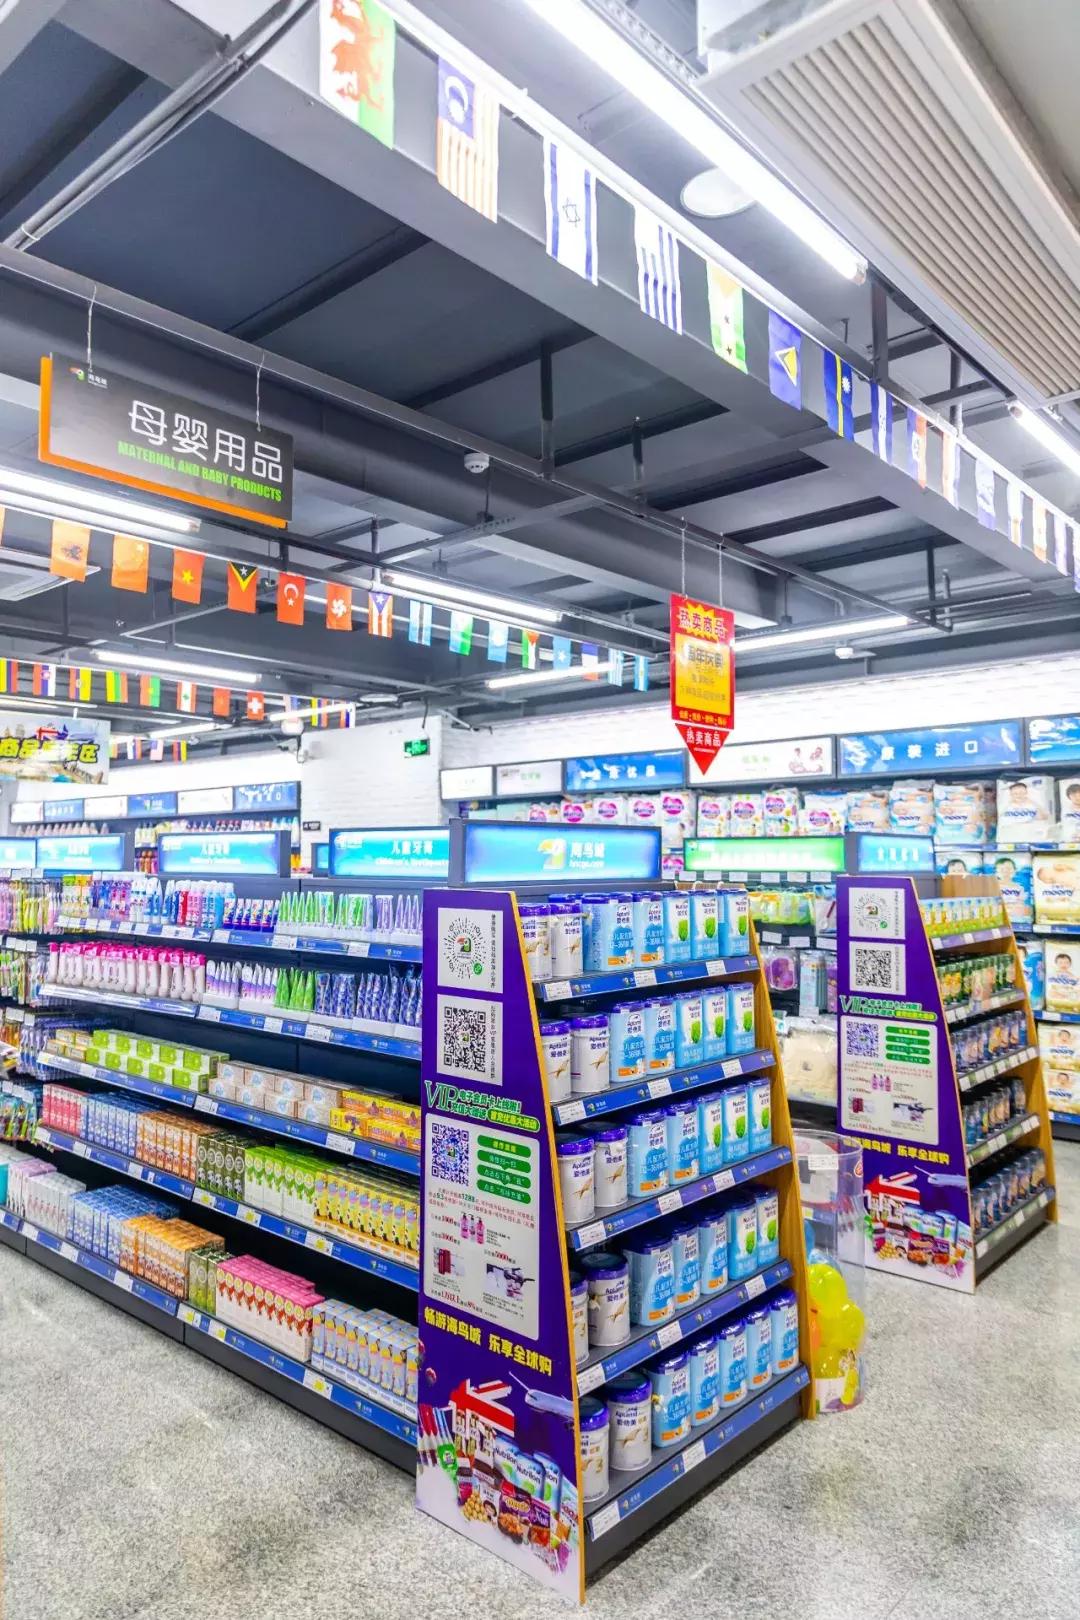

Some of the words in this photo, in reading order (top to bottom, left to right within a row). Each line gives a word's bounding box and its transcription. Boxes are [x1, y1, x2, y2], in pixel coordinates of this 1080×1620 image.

[128, 400, 283, 483] 母婴用品
[117, 441, 177, 471] MATERNAL
[178, 460, 200, 478] AND
[202, 466, 229, 486] BABY
[230, 475, 283, 502] PRODUCTS
[679, 607, 727, 640] 热卖商品
[686, 727, 721, 747] 热卖商品
[424, 1079, 459, 1111] VIP
[424, 1306, 482, 1346] 畅游海鸟城
[489, 1333, 552, 1376] 乐享全球购
[517, 1464, 541, 1484] Nutrilon
